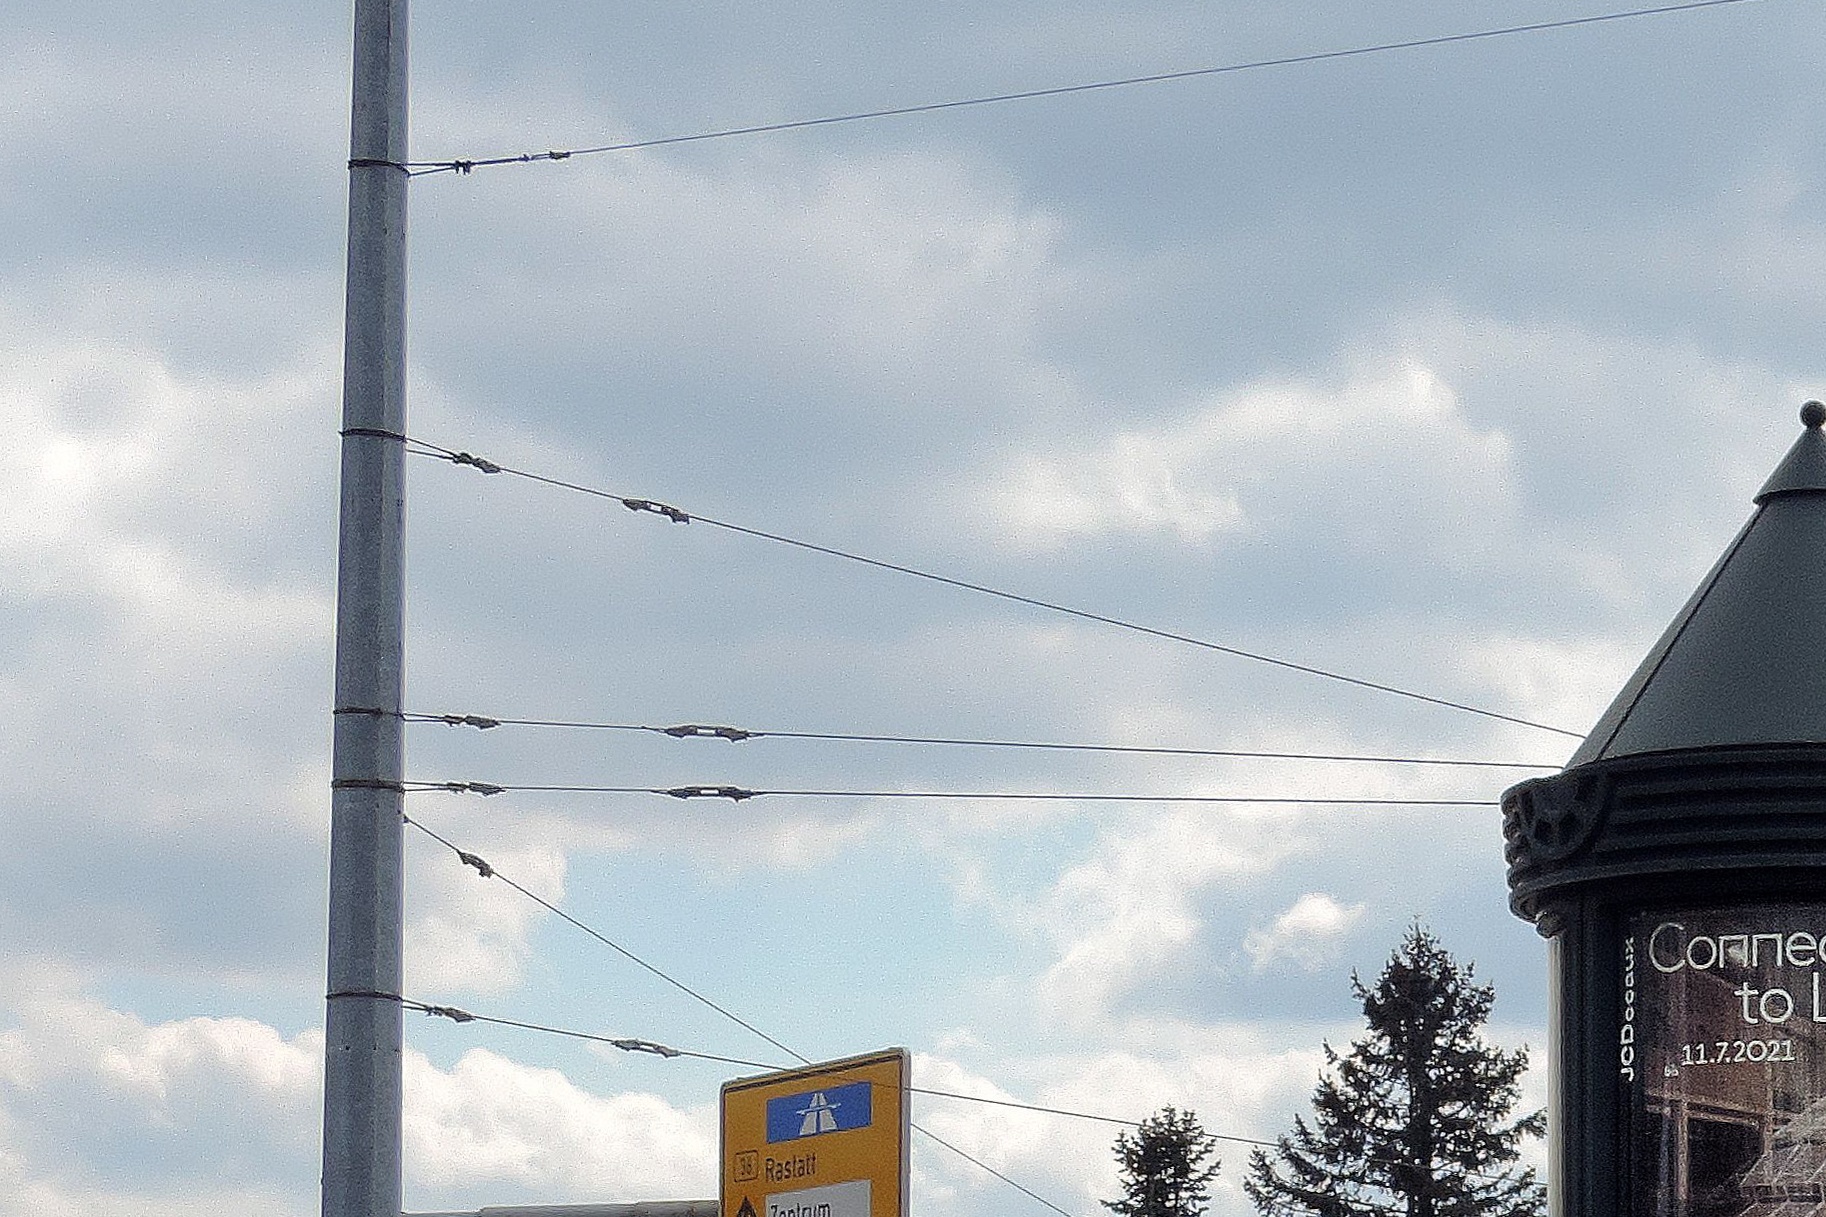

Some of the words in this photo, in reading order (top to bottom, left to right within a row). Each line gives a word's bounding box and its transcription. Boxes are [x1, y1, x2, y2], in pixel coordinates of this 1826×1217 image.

[1733, 979, 1794, 1024] to
[1682, 1040, 1796, 1066] 11.7.2021
[766, 1152, 816, 1183] Rastatt
